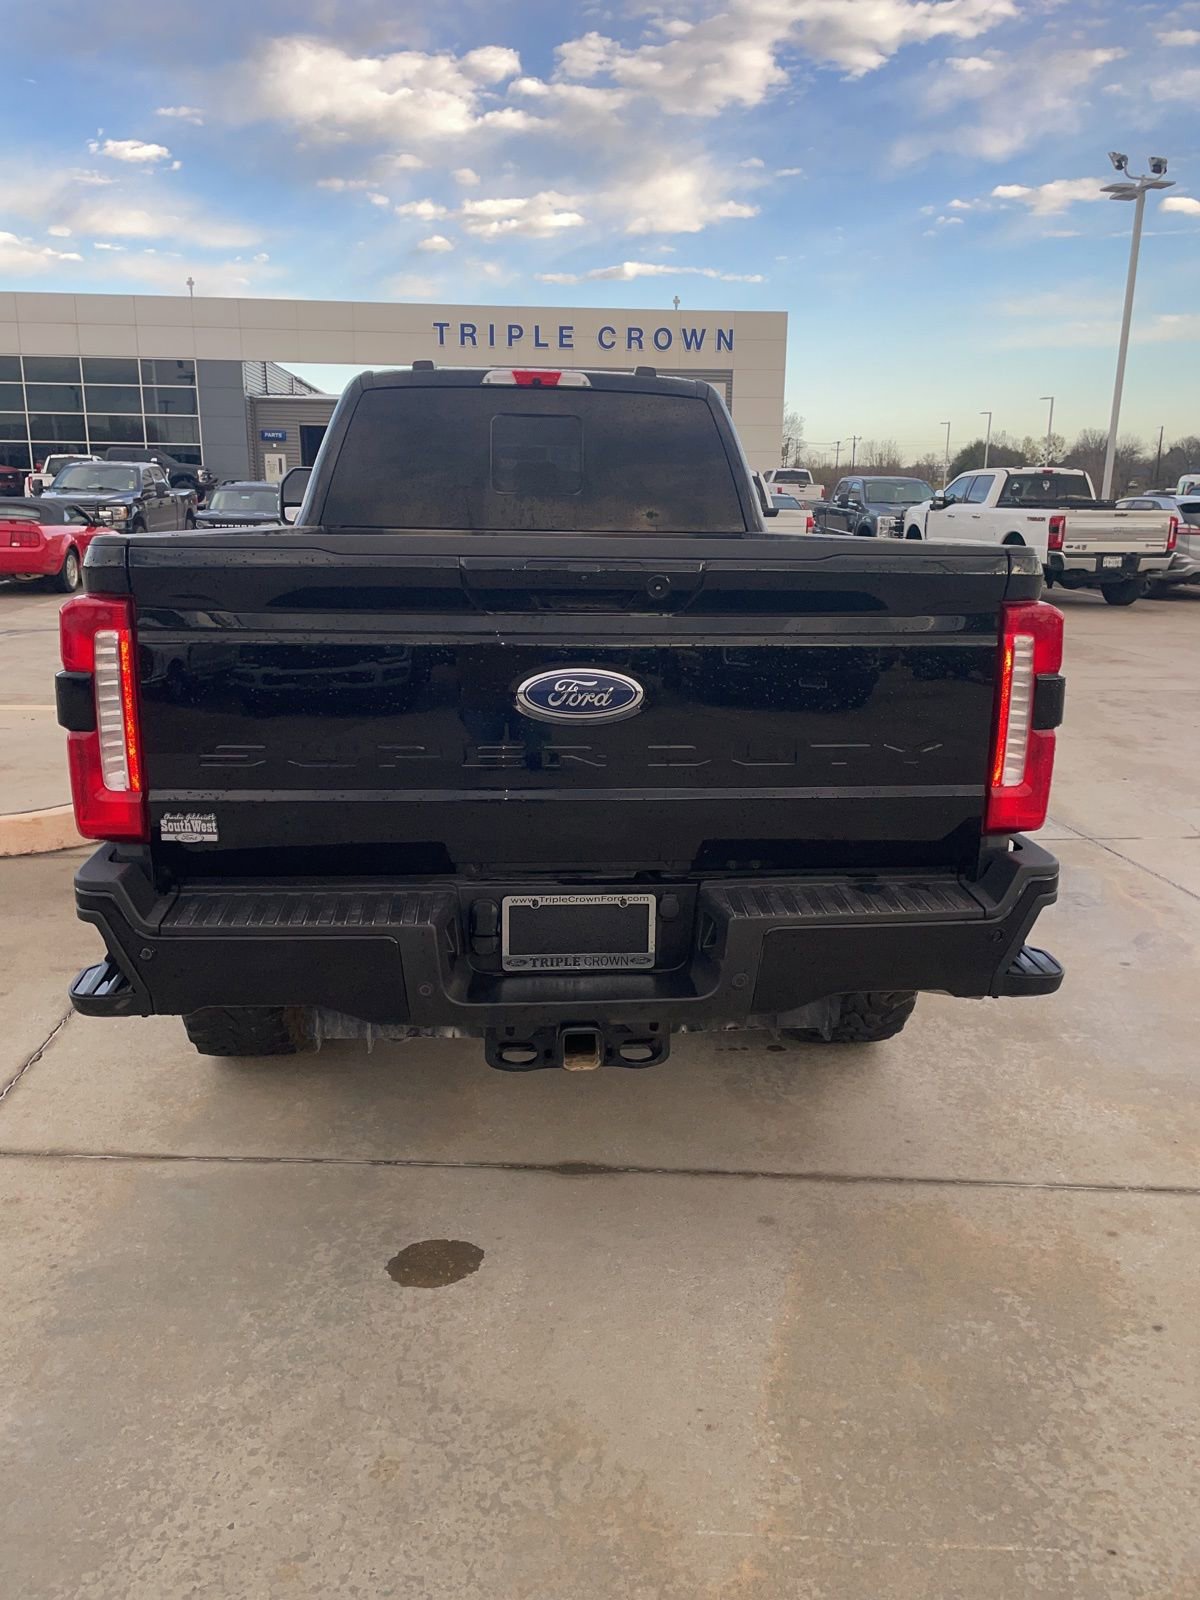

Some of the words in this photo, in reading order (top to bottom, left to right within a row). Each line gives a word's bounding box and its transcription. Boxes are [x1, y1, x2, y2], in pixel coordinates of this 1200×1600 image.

[432, 322, 575, 349] TRIPLE
[597, 326, 734, 351] CROWN
[548, 679, 614, 707] Ford
[199, 744, 608, 768] SUPER
[647, 742, 944, 767] DUTY
[160, 819, 217, 832] SouthWest
[510, 895, 649, 904] wwwTripleCrownFordcom
[529, 956, 581, 968] TRIPLE
[583, 955, 629, 967] CROWN
